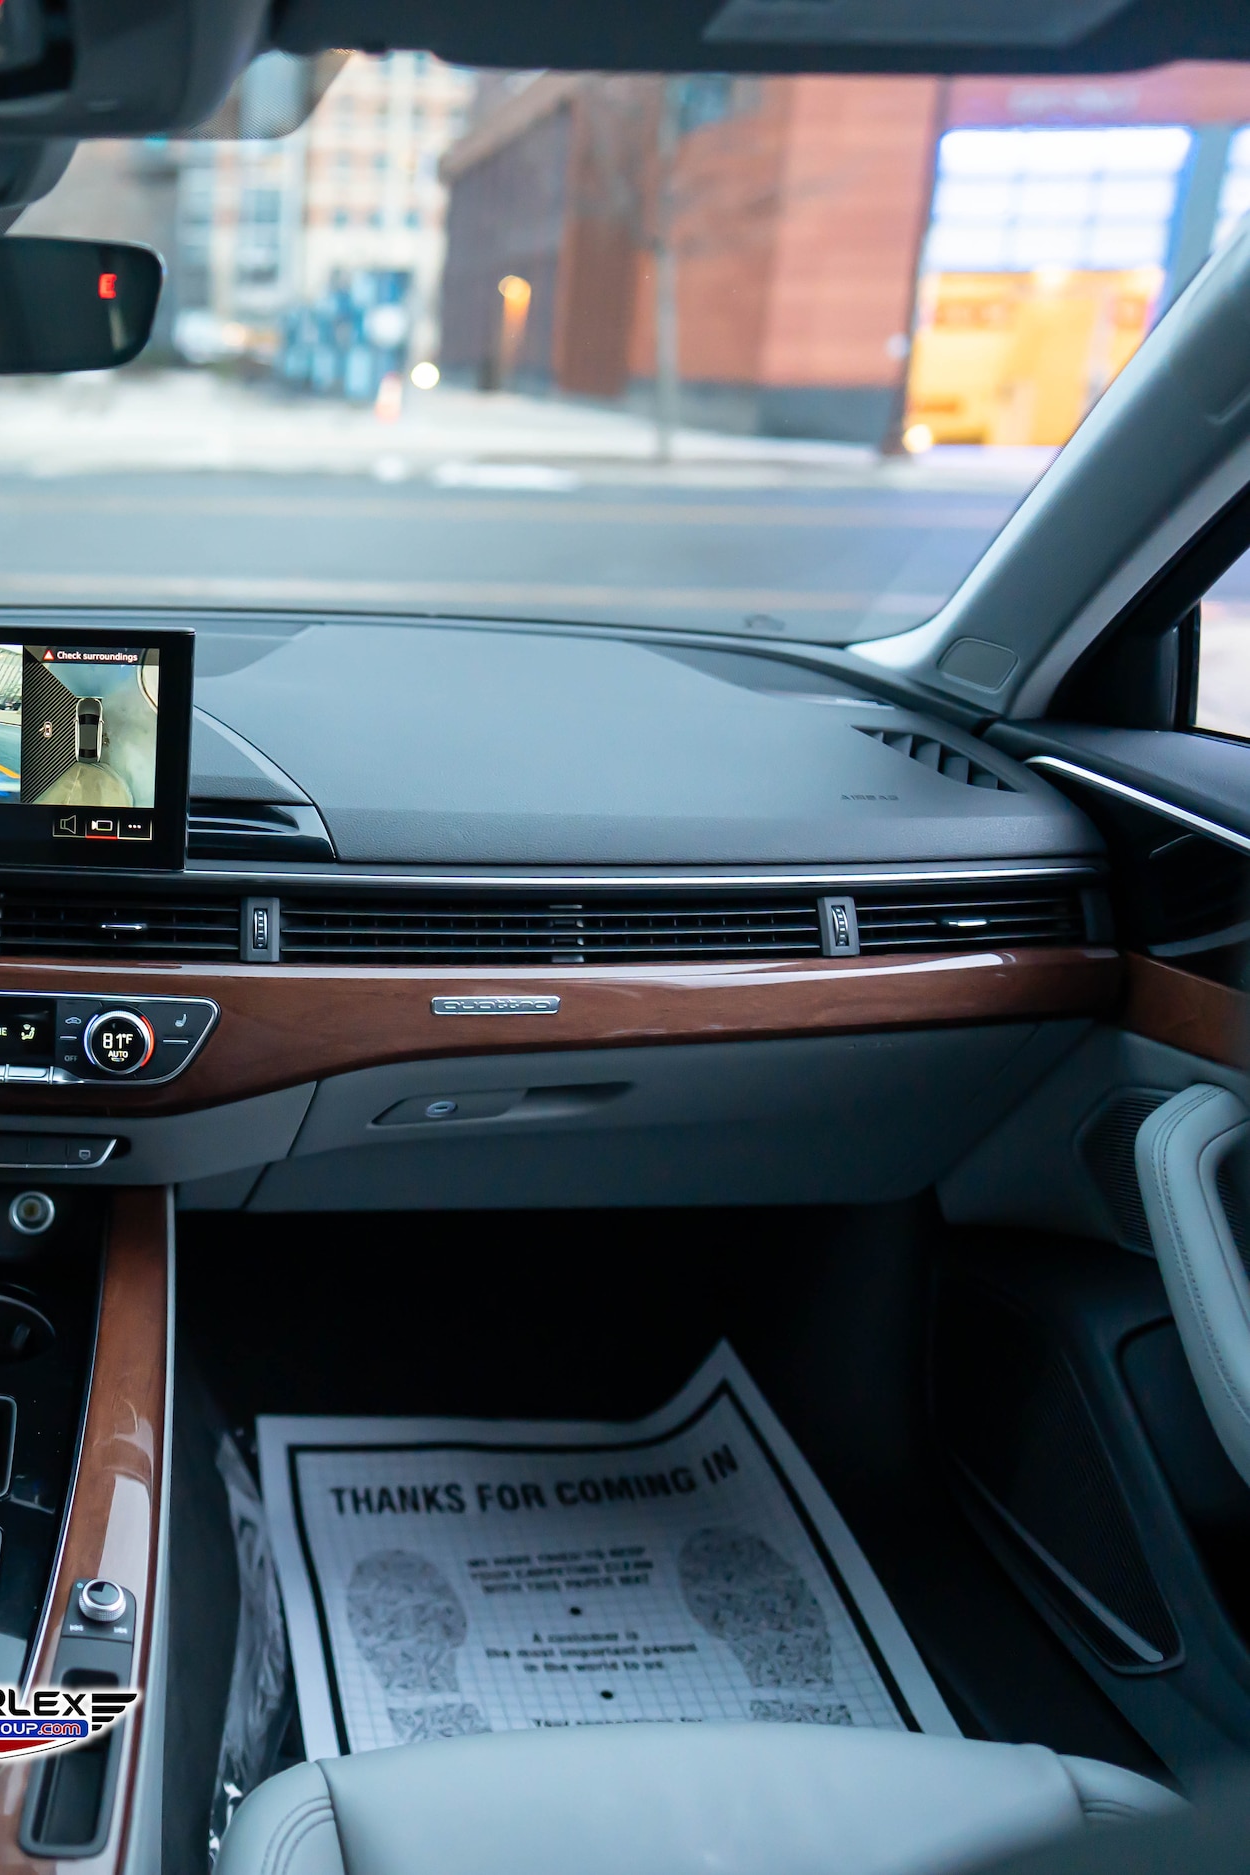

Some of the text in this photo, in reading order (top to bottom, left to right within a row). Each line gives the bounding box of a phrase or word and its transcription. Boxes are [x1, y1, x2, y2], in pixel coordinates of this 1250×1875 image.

[57, 651, 138, 662] Check surroundings
[443, 999, 551, 1009] quattro
[103, 1032, 134, 1049] 81°F
[107, 1050, 129, 1059] AUTO
[329, 1443, 739, 1516] THANKS FOR COMING IN
